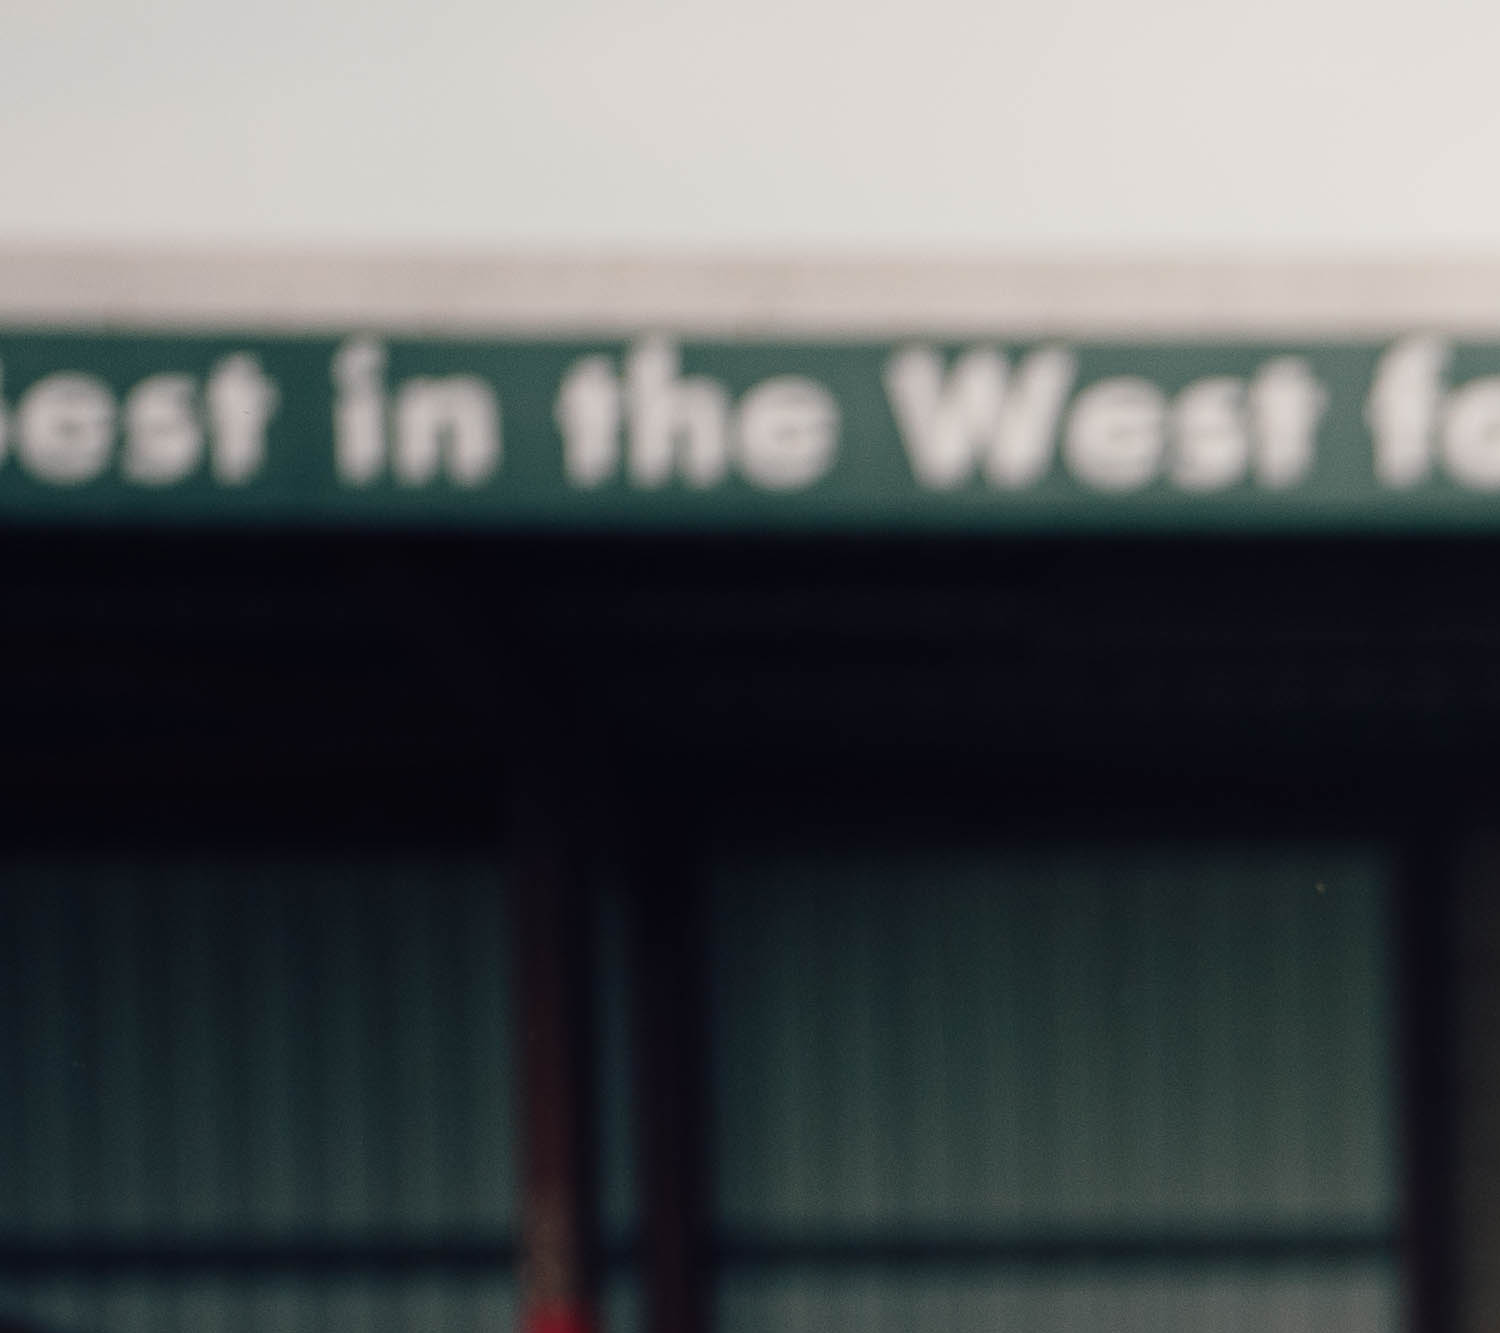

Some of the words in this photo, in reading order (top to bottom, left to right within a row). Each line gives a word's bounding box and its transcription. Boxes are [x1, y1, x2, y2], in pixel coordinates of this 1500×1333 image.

[0, 348, 278, 488] est
[332, 334, 504, 488] in
[556, 334, 840, 494] the
[884, 342, 1326, 494] West
